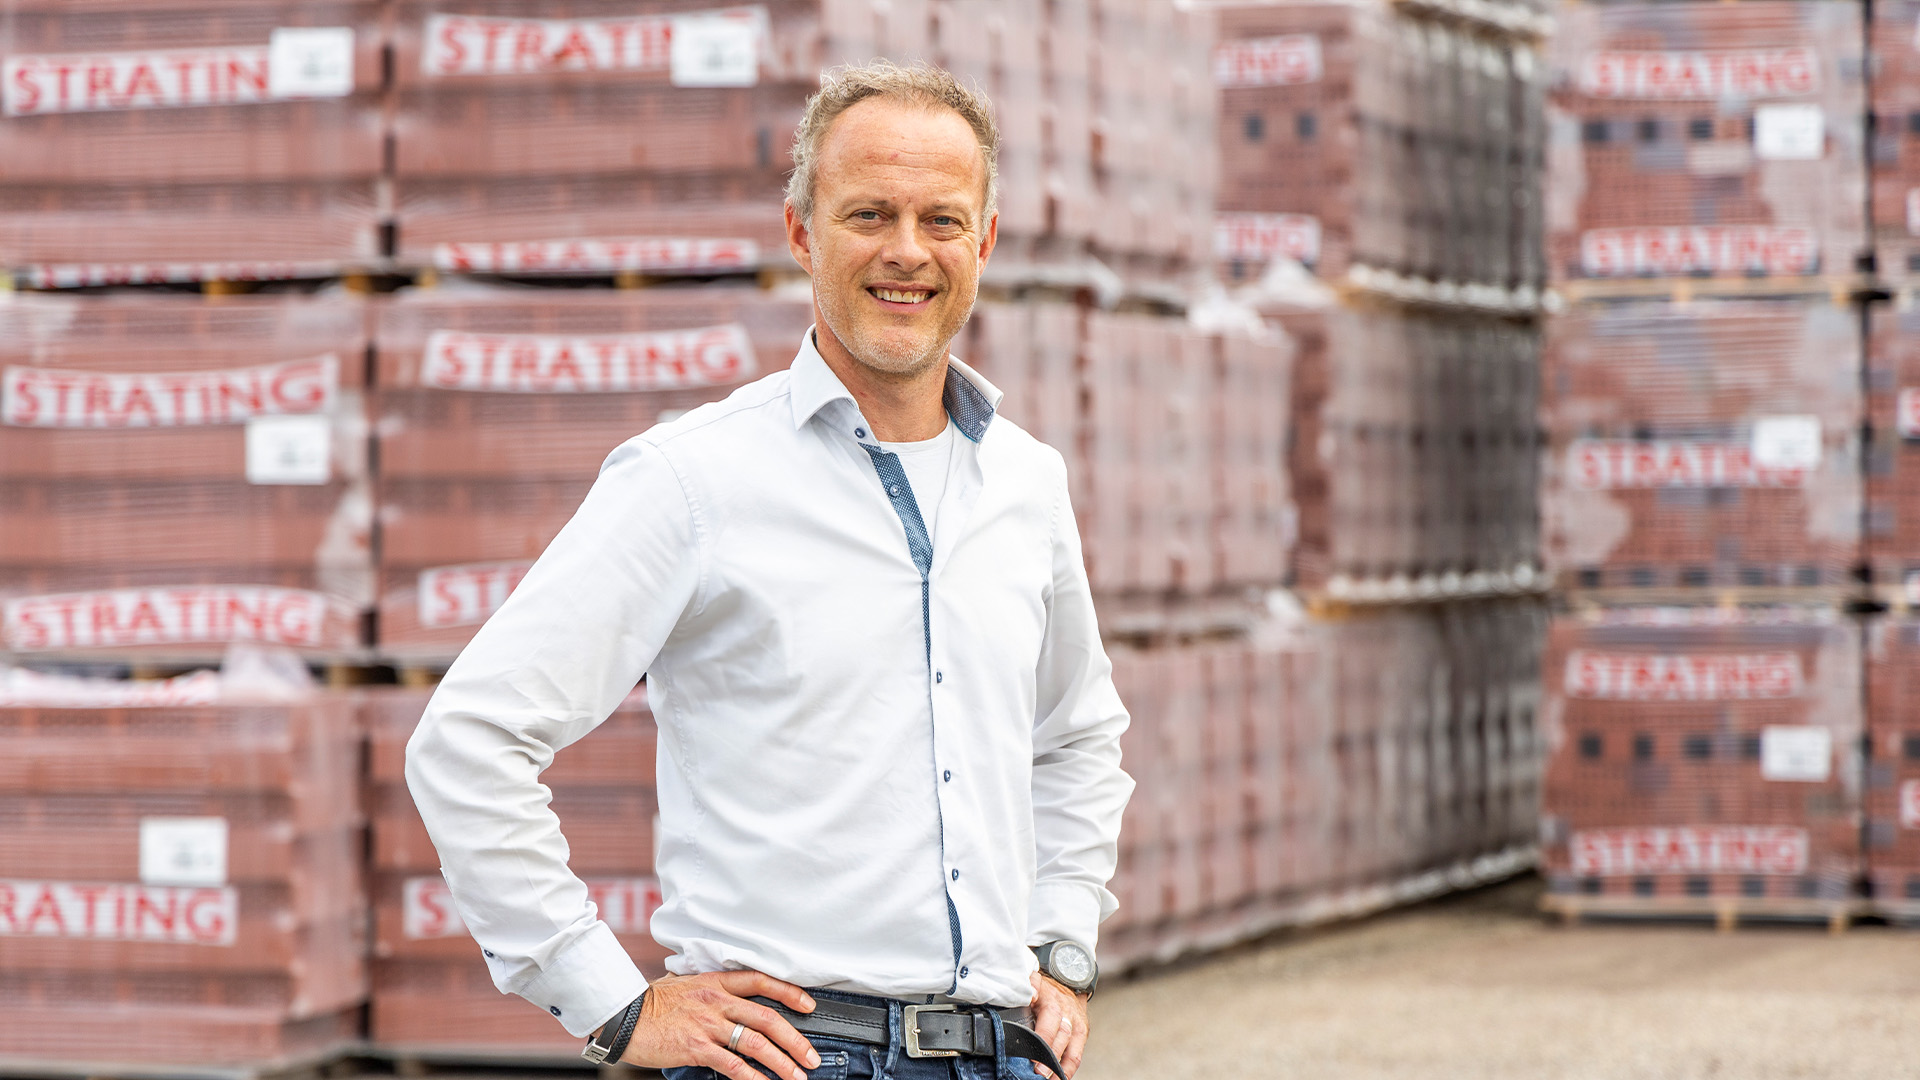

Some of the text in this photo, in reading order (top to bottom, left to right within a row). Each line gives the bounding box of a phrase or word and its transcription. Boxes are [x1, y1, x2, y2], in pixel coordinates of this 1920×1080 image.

[13, 58, 270, 112] STRATIN
[1593, 53, 1814, 95] STRATING
[1593, 230, 1812, 275] STRATING
[438, 332, 742, 388] STRATING
[14, 363, 326, 425] STRATING
[22, 590, 314, 646] STRATING
[1577, 655, 1794, 696] STRATING
[1583, 828, 1800, 872] STRATING
